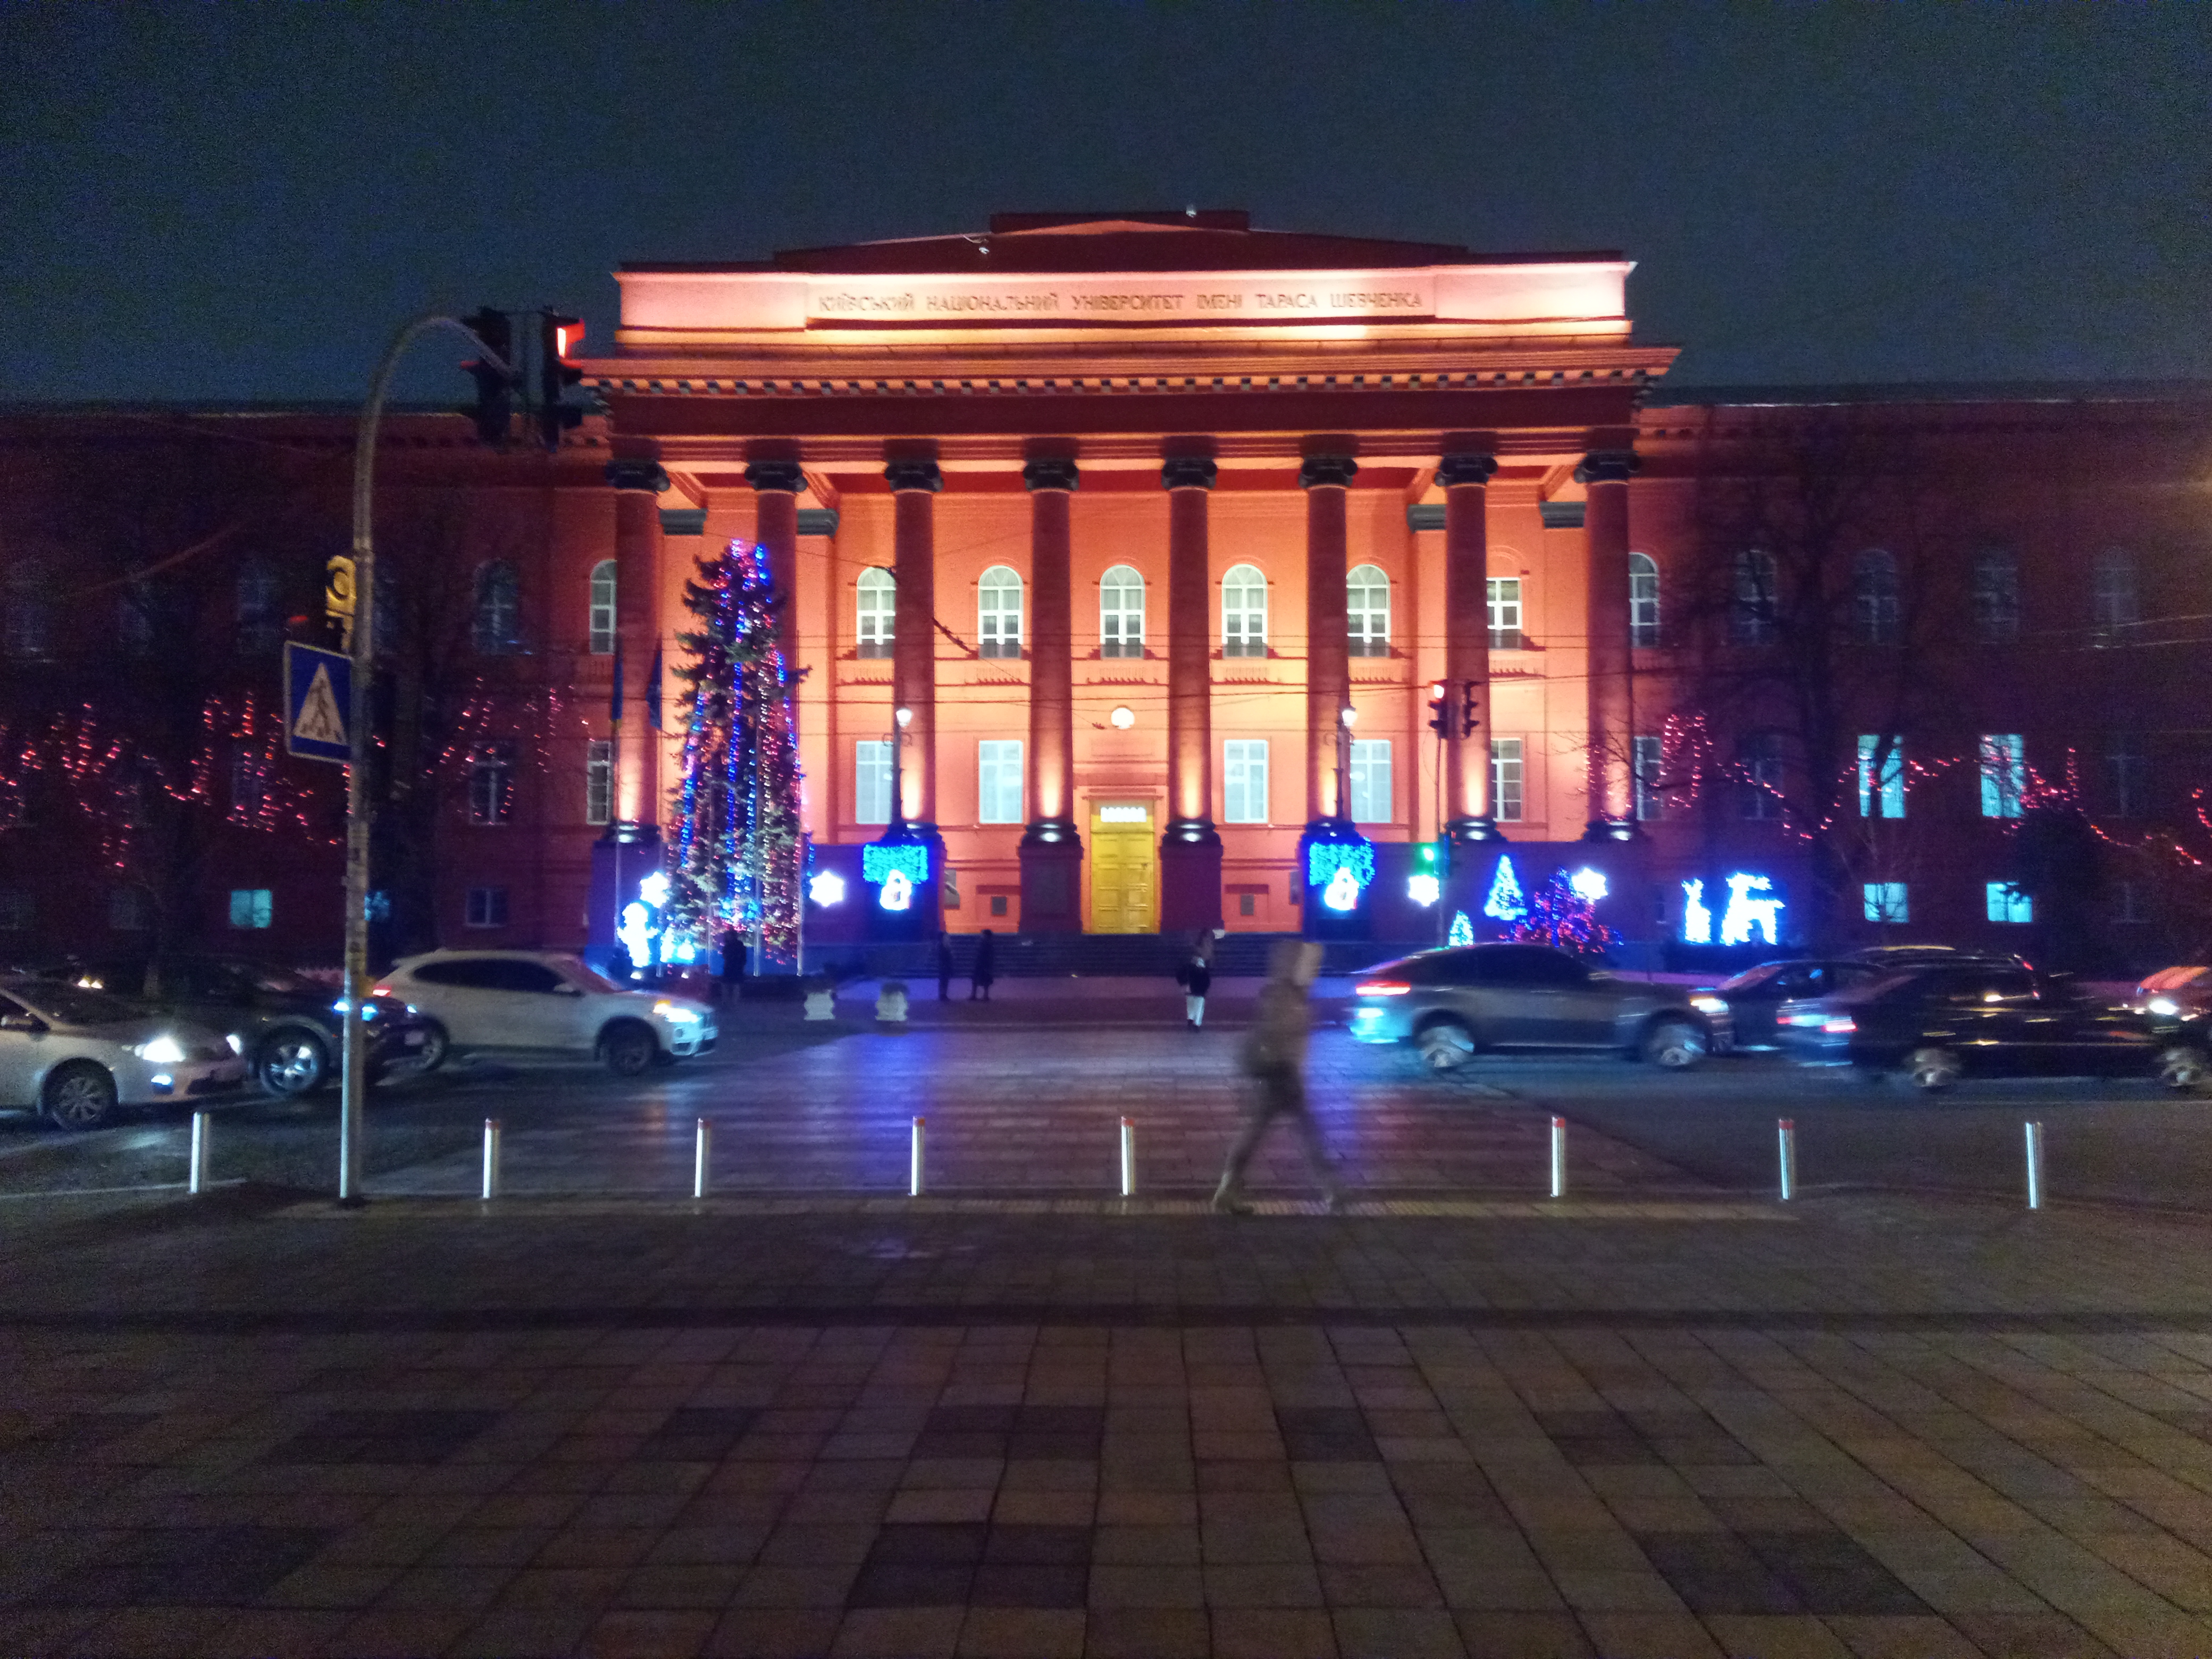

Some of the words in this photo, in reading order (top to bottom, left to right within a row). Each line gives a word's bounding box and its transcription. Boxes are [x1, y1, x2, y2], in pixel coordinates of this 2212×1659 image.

[927, 292, 1060, 311] НАЦІОНАЛЬНИЙ
[1071, 294, 1184, 311] УНІВЕРСИТЕТ
[1196, 294, 1243, 309] ІМЕНІ
[1255, 294, 1318, 309] ТАРАСА
[1330, 293, 1422, 308] ШЕВЧЕНКА
